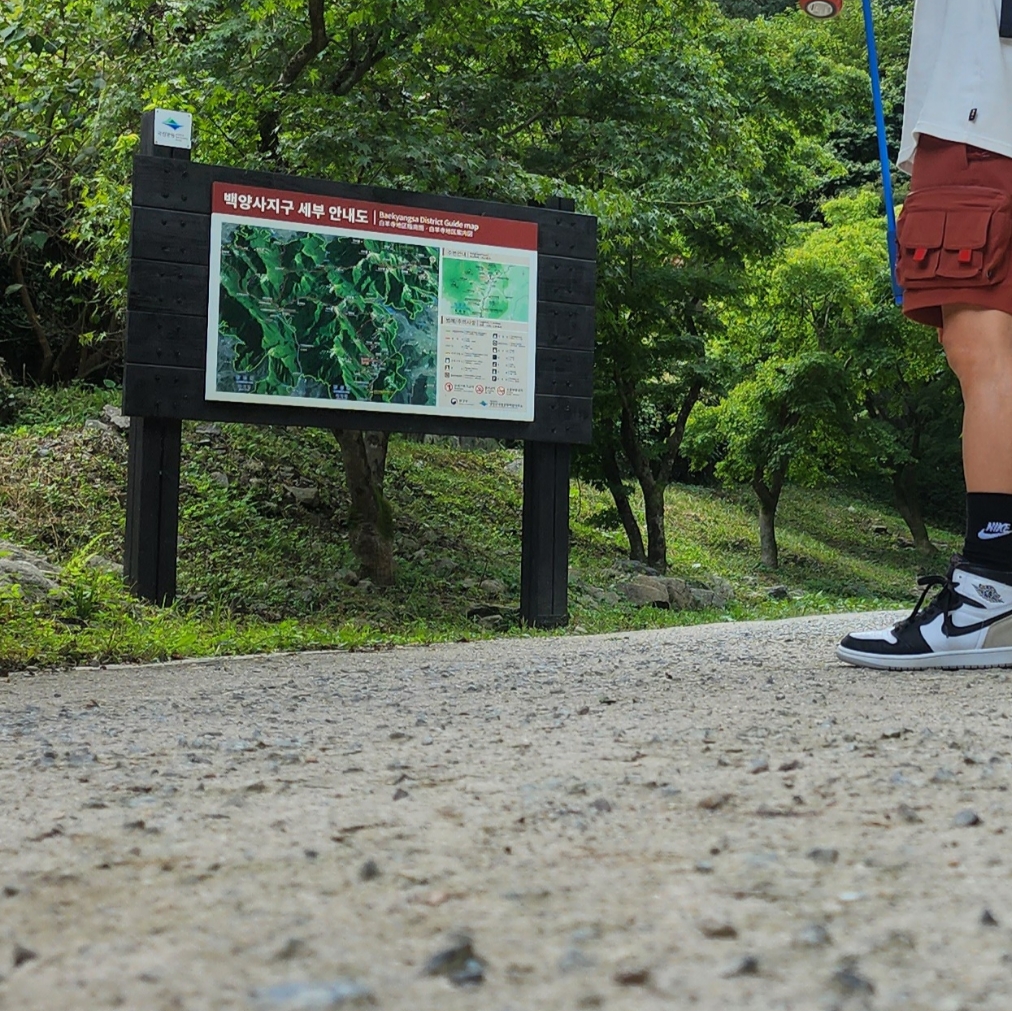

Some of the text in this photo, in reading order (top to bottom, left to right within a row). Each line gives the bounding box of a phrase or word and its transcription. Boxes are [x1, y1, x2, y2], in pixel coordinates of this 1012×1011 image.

[223, 192, 369, 224] 백양사지구 세부 안내도
[379, 211, 479, 232] Baekyangsa District Guide map
[986, 521, 1011, 533] NIKE
